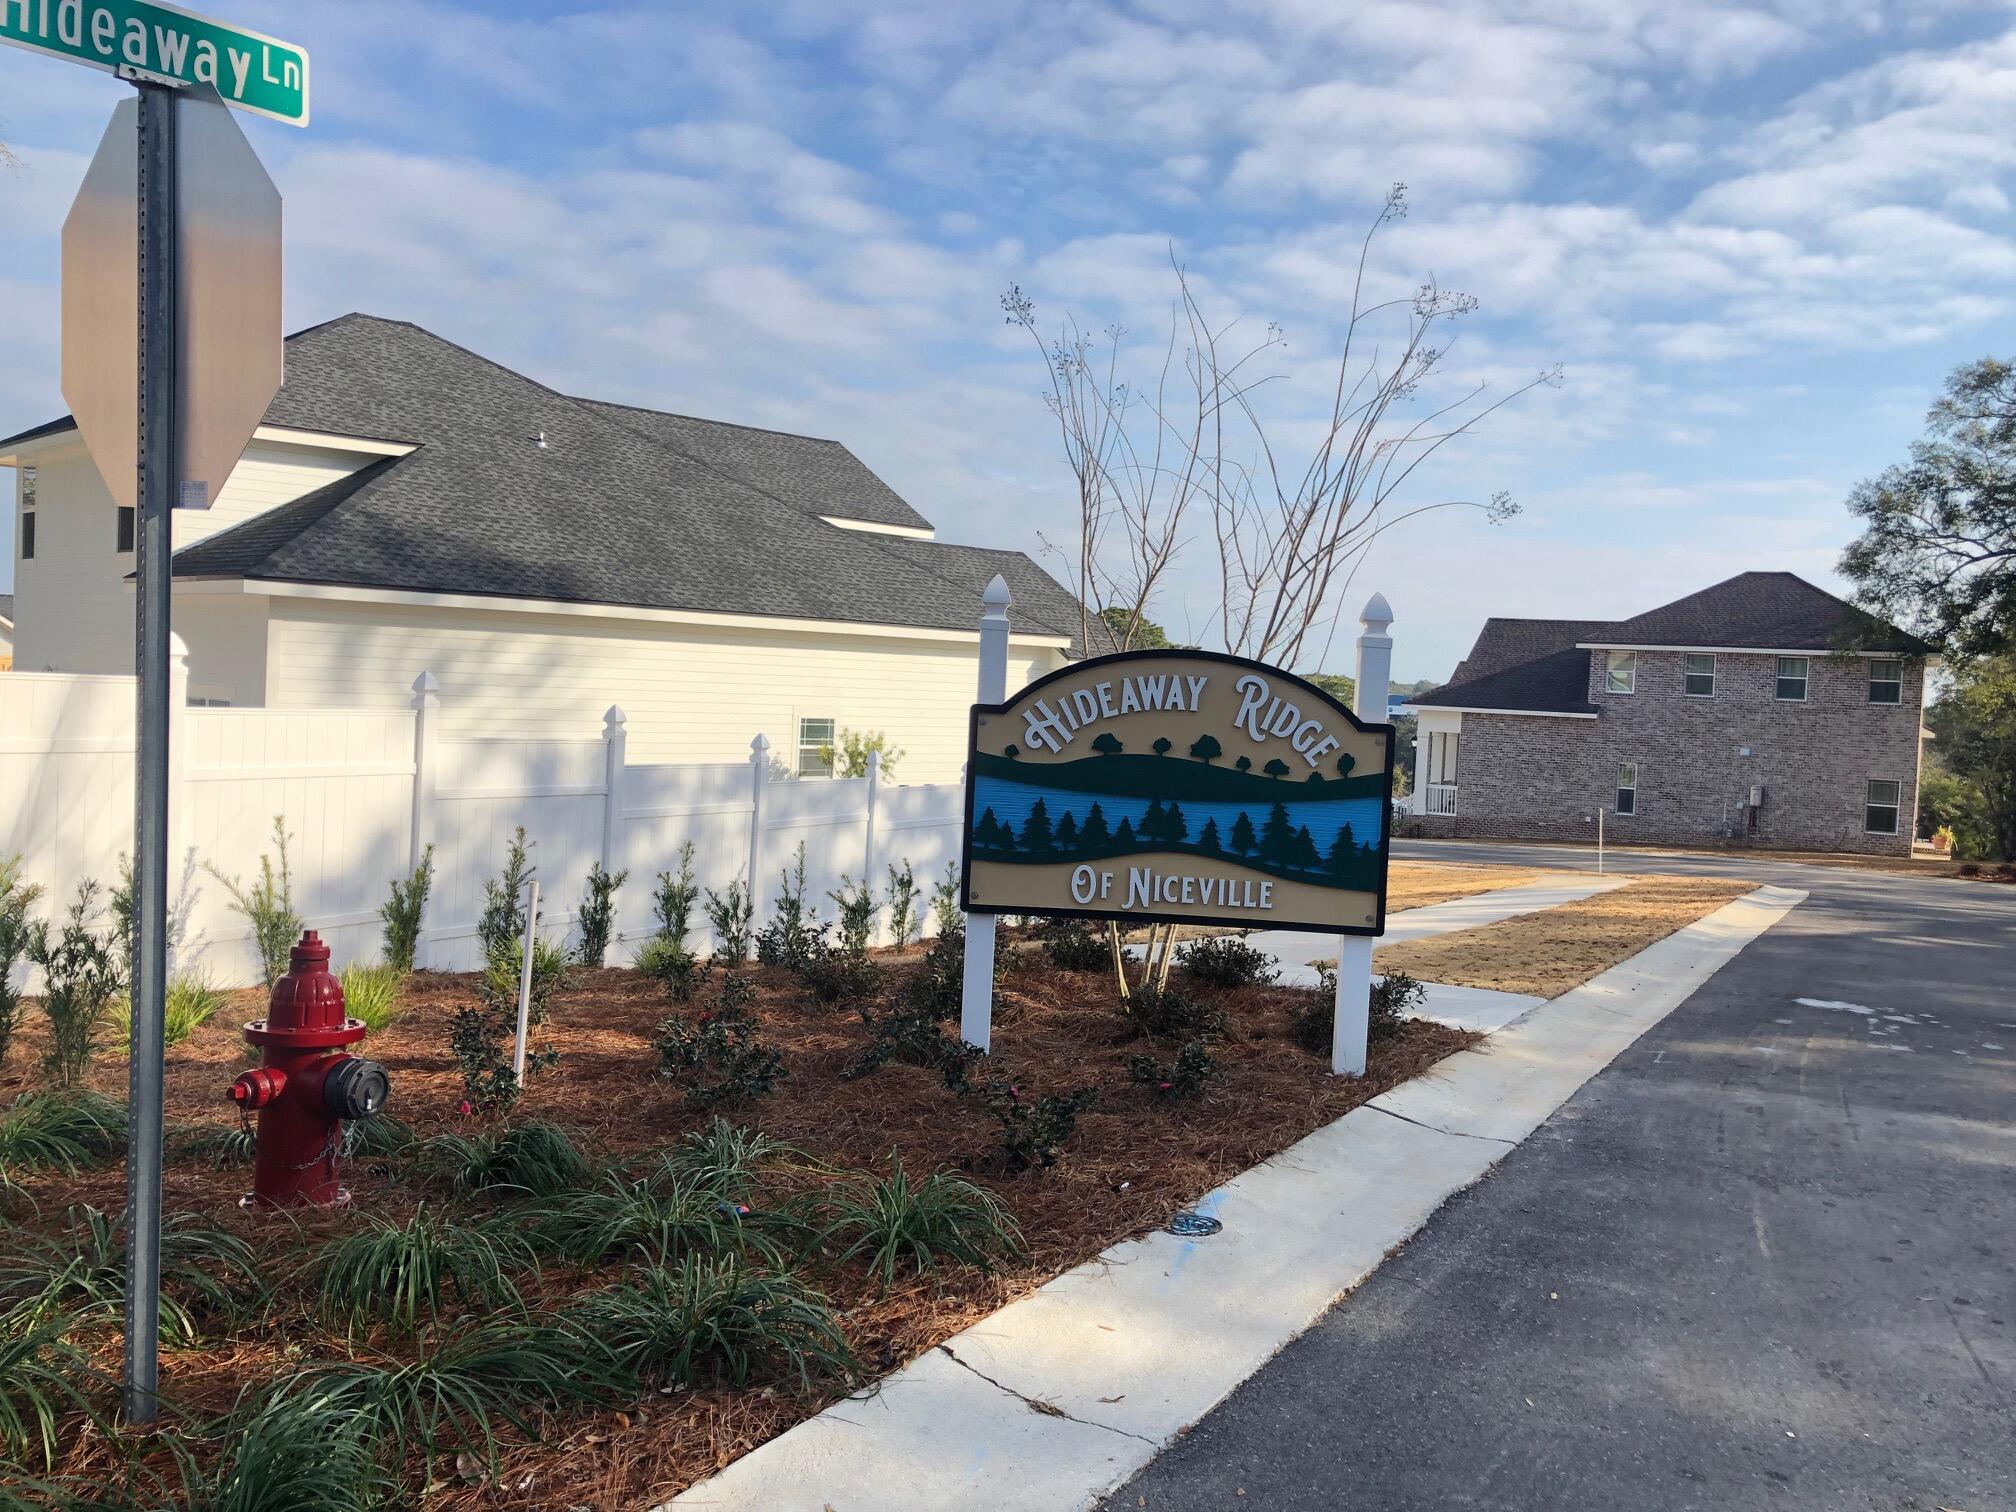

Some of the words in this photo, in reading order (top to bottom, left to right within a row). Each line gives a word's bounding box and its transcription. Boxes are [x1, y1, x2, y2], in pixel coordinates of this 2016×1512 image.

[262, 45, 300, 91] Ln
[1022, 674, 1209, 754] HIDEAWAY
[1234, 674, 1341, 768] RIDGE
[1070, 864, 1114, 905] OF
[1121, 867, 1273, 909] NICEVILLE
